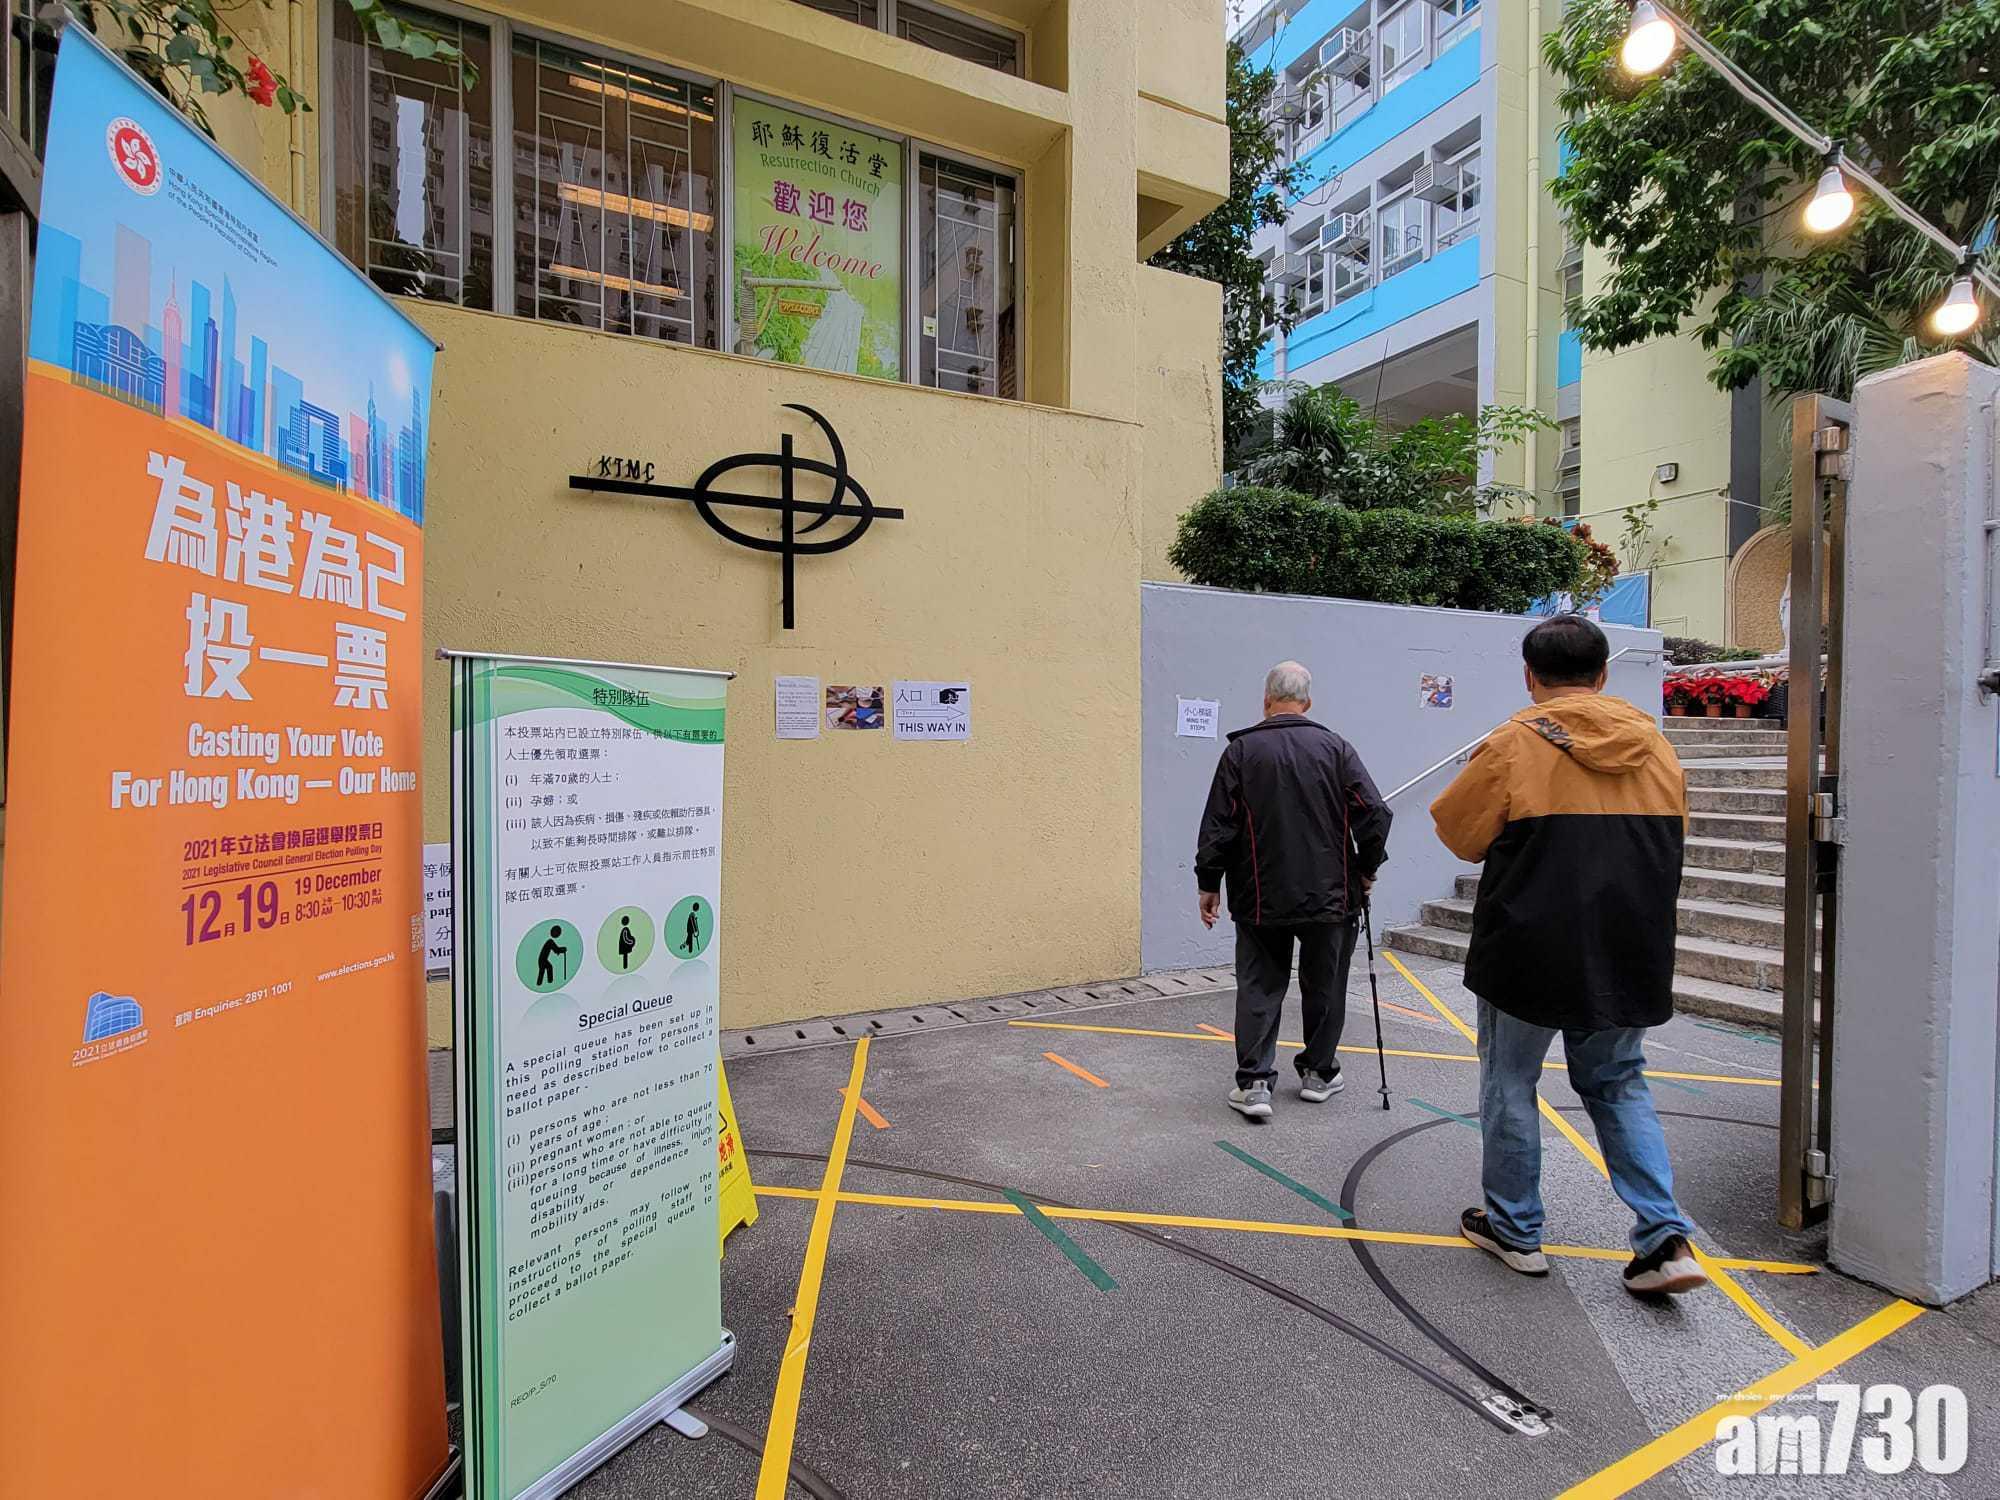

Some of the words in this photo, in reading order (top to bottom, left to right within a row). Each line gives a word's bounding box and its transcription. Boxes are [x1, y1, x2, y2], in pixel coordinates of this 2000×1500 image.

[751, 119, 888, 179] 耶穌復活堂
[760, 153, 836, 179] Resurrection
[841, 169, 880, 198] Church
[773, 180, 868, 232] 歡迎您
[759, 224, 885, 280] Welcome
[598, 455, 655, 482] KTMC
[145, 450, 406, 621] 為港為己
[184, 592, 389, 709] 投一票
[593, 688, 649, 706] 特別隊伍
[189, 723, 280, 763] Casting
[286, 728, 336, 757] Your
[341, 729, 384, 757] Vote
[898, 722, 924, 733] THIS
[927, 722, 952, 733] WAY
[955, 723, 966, 733] IN
[111, 771, 162, 809] For
[169, 770, 228, 808] Hong
[237, 769, 300, 804] Kong
[340, 767, 376, 795] Our
[381, 767, 416, 793] Home
[506, 775, 518, 786] (i)
[506, 797, 522, 808] (ii)
[184, 823, 382, 861] 2021年立法會換屆選舉投票日
[506, 818, 526, 831] (iii)
[182, 867, 200, 880] 2021
[204, 861, 250, 877] Legislative
[252, 855, 283, 869] Council
[286, 852, 313, 865] General
[315, 849, 343, 860] Election
[346, 846, 369, 857] Polling
[295, 877, 311, 895] 19
[316, 868, 381, 892] December
[295, 900, 320, 921] 8:30
[195, 998, 242, 1019] Enquiries:
[245, 989, 267, 1004] 2891
[272, 981, 292, 995] 1001
[578, 1003, 628, 1028] Special
[632, 995, 673, 1013] Queue
[506, 1062, 514, 1072] A
[523, 1047, 566, 1068] special
[574, 1037, 607, 1054] queue
[614, 1029, 632, 1040] has
[639, 1020, 663, 1032] been
[670, 1013, 684, 1024] set
[690, 1010, 701, 1019] up
[706, 1004, 712, 1014] in
[506, 1074, 530, 1087] this
[541, 1058, 582, 1079] polling
[592, 1044, 629, 1061] station
[638, 1036, 652, 1046] for
[661, 1022, 699, 1041] persons
[706, 1017, 712, 1025] in
[506, 1085, 536, 1103] need
[543, 1080, 557, 1090] as
[563, 1059, 618, 1083] described
[624, 1050, 654, 1064] below
[659, 1044, 669, 1053] to
[674, 1032, 705, 1048] collect
[506, 1098, 543, 1117] ballot
[547, 1086, 580, 1105] paper
[507, 1133, 520, 1148] (i)
[530, 1114, 577, 1140] persons
[584, 1104, 605, 1118] who
[611, 1096, 627, 1108] are
[634, 1087, 649, 1099] not
[655, 1079, 674, 1091] less
[680, 1070, 700, 1083] than
[704, 1063, 713, 1073] 70
[507, 1161, 525, 1178] (ii)
[530, 1139, 582, 1169] pregnant
[587, 1123, 623, 1144] women
[634, 1115, 645, 1125] or
[530, 1133, 562, 1155] years
[567, 1125, 578, 1138] of
[582, 1119, 601, 1132] age
[530, 1182, 547, 1195] for
[552, 1178, 558, 1186] a
[562, 1166, 587, 1182] long
[591, 1154, 614, 1169] time
[619, 1147, 629, 1158] or
[633, 1136, 656, 1152] have
[660, 1117, 702, 1140] difficulty
[706, 1112, 712, 1121] in
[582, 1146, 604, 1159] who
[609, 1136, 625, 1149] are
[630, 1127, 646, 1140] not
[650, 1118, 670, 1132] able
[674, 1113, 684, 1122] to
[687, 1101, 712, 1118] queue
[530, 1194, 584, 1224] disability
[603, 1181, 614, 1191] or
[630, 1148, 689, 1178] dependence
[703, 1137, 712, 1147] on
[530, 1184, 577, 1210] queuing
[589, 1162, 627, 1184] because
[637, 1152, 645, 1163] of
[509, 1244, 561, 1277] Relevant
[575, 1218, 618, 1247] persons
[630, 1202, 650, 1217] may
[661, 1182, 690, 1202] follow
[700, 1171, 712, 1183] the
[509, 1249, 581, 1292] instructions
[597, 1234, 607, 1246] of
[623, 1211, 657, 1236] polling
[671, 1192, 692, 1209] staff
[704, 1184, 712, 1192] to
[530, 1210, 578, 1239] mobility
[582, 1198, 609, 1214] aids.
[509, 1274, 557, 1309] proceed
[570, 1264, 581, 1274] to
[593, 1249, 610, 1262] the
[621, 1222, 657, 1248] special
[667, 1205, 695, 1224] queue
[704, 1196, 712, 1205] to
[509, 1293, 550, 1321] collect
[555, 1288, 561, 1296] a
[566, 1267, 597, 1290] ballot
[602, 1251, 633, 1273] paper.
